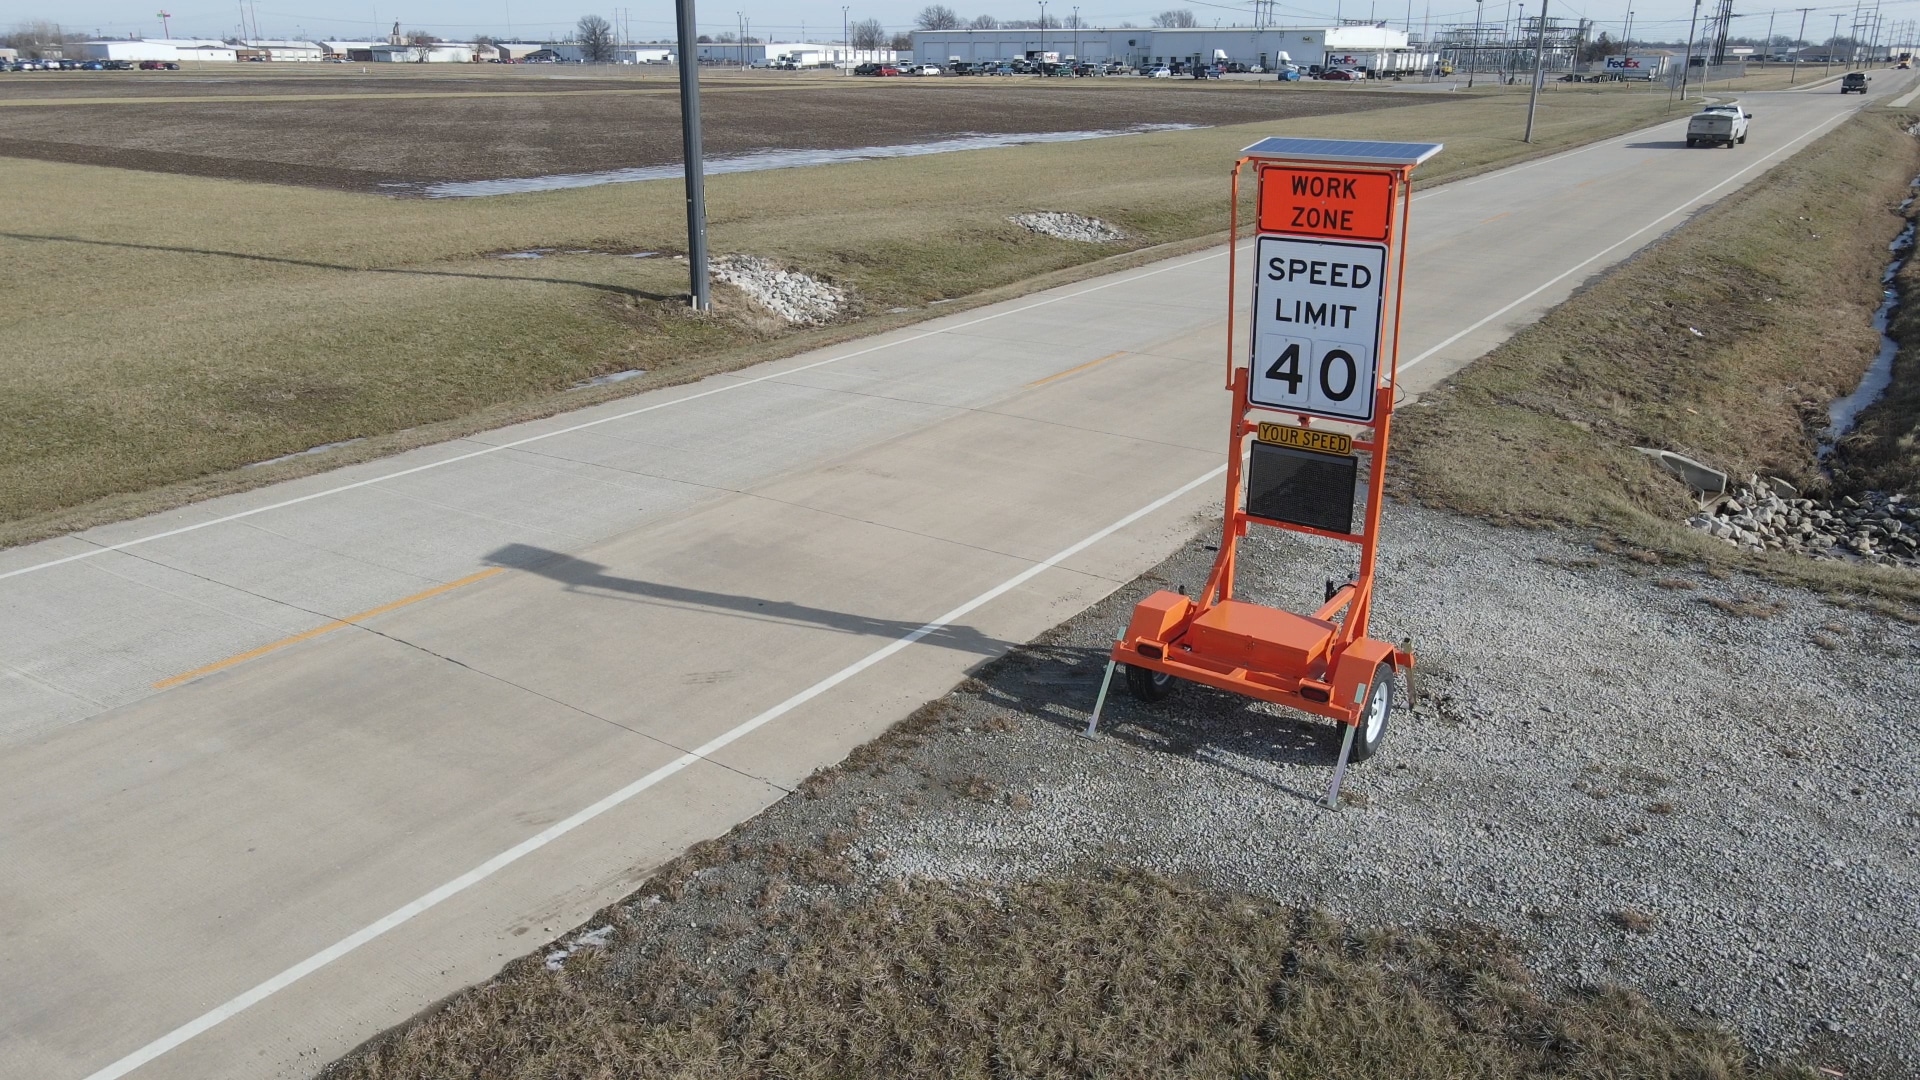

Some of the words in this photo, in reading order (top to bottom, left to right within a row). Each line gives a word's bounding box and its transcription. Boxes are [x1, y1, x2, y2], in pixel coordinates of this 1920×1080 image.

[1329, 55, 1358, 65] FedEx
[1606, 57, 1640, 68] FedEx
[1291, 175, 1357, 199] WORK
[1290, 206, 1354, 231] ZONE
[1267, 257, 1372, 289] SPEED
[1275, 298, 1357, 329] LIMIT
[1265, 343, 1357, 402] 40
[1262, 424, 1299, 444] YOUR
[1302, 431, 1347, 452] SPEED
